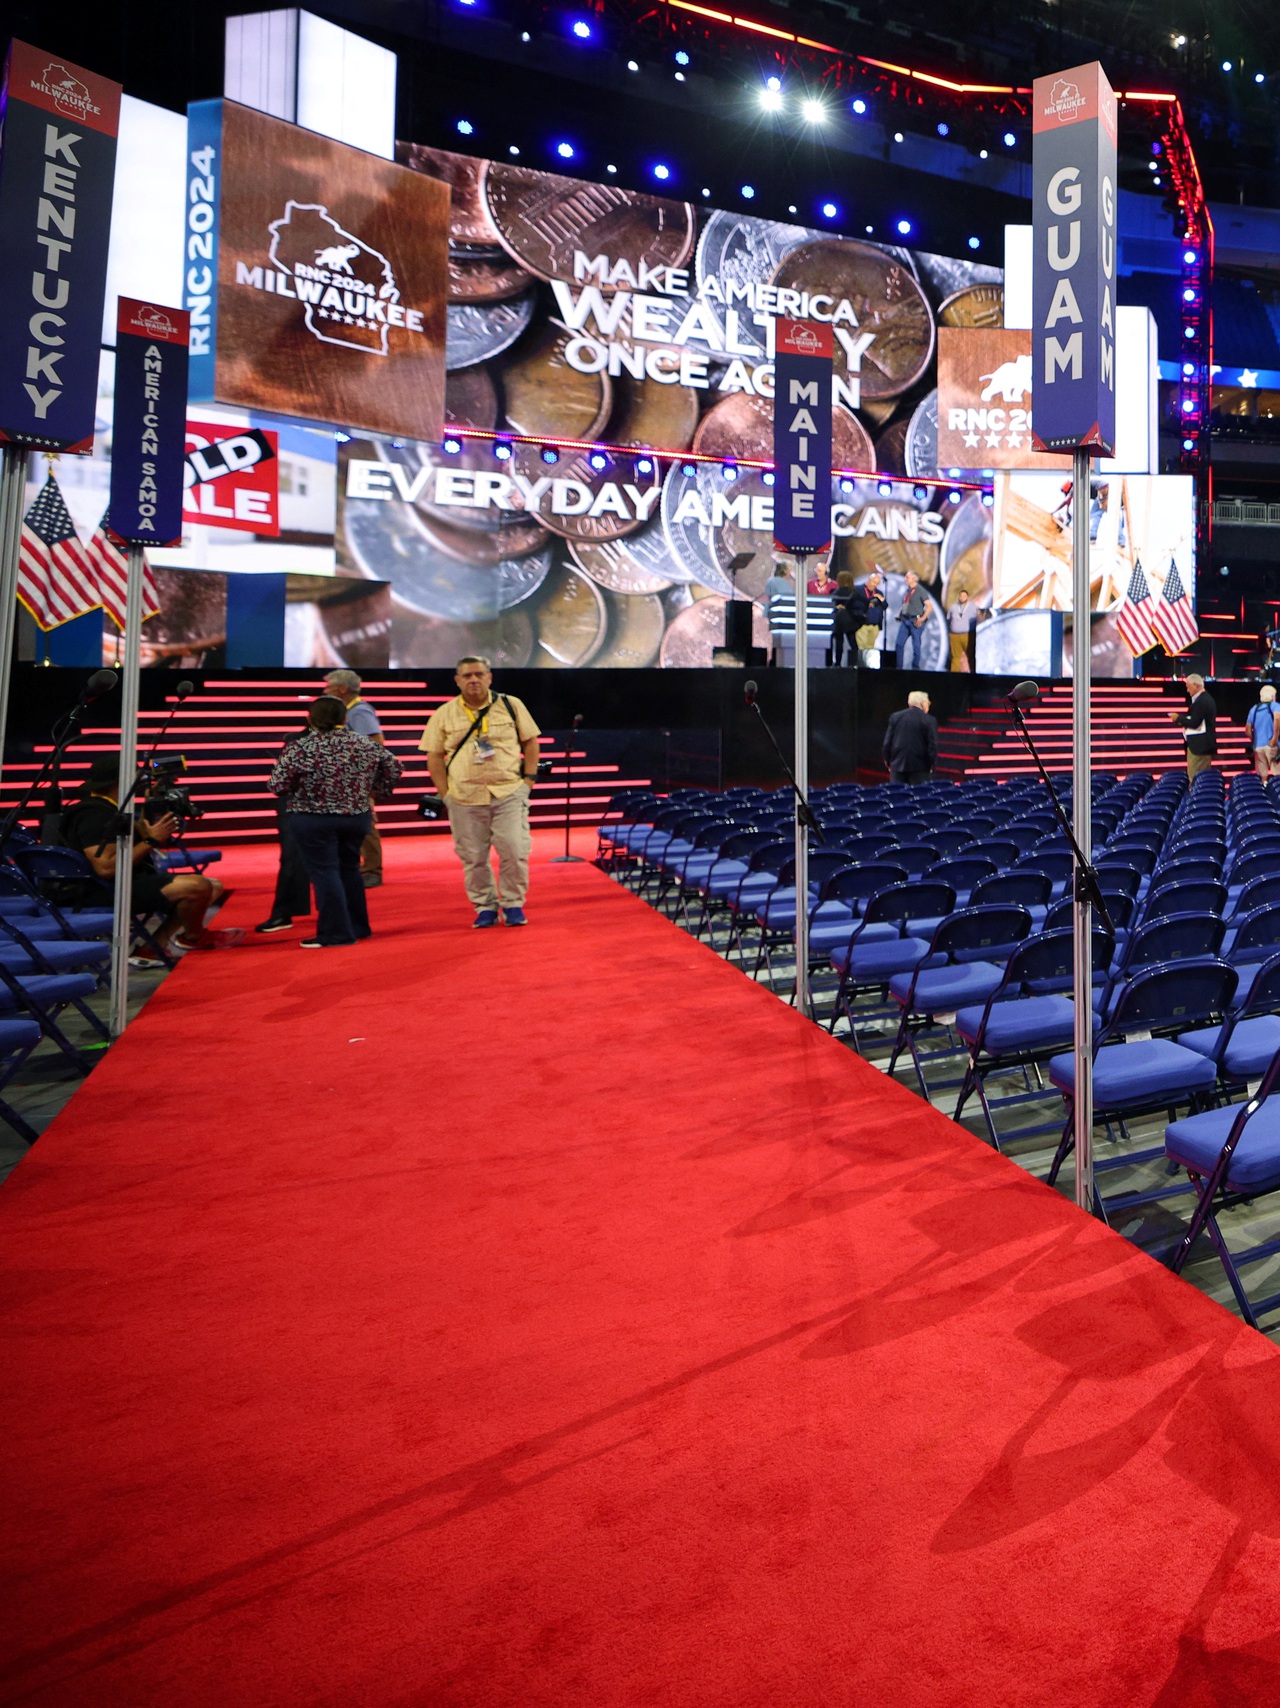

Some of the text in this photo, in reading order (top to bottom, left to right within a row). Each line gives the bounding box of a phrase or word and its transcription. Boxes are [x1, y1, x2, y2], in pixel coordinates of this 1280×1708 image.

[30, 80, 101, 115] MILWAUKEE
[1044, 97, 1086, 115] MILWAUKEE
[23, 124, 83, 419] KENTUCKY
[189, 145, 216, 355] RNC 2024
[295, 262, 376, 297] RNC 2024
[574, 250, 859, 327] MAKE AMERICA
[1044, 166, 1083, 385] GUAM
[1101, 176, 1114, 393] GUAM
[236, 261, 424, 332] MILWAUKEE
[550, 279, 877, 372] WEALTY
[142, 345, 162, 456] AMERICAN
[565, 337, 860, 410] ONCE AGN
[789, 379, 819, 519] MAINE
[949, 408, 1006, 431] RNC
[138, 462, 157, 531] SAMOA
[346, 458, 945, 544] EVERYDAY AMECANS
